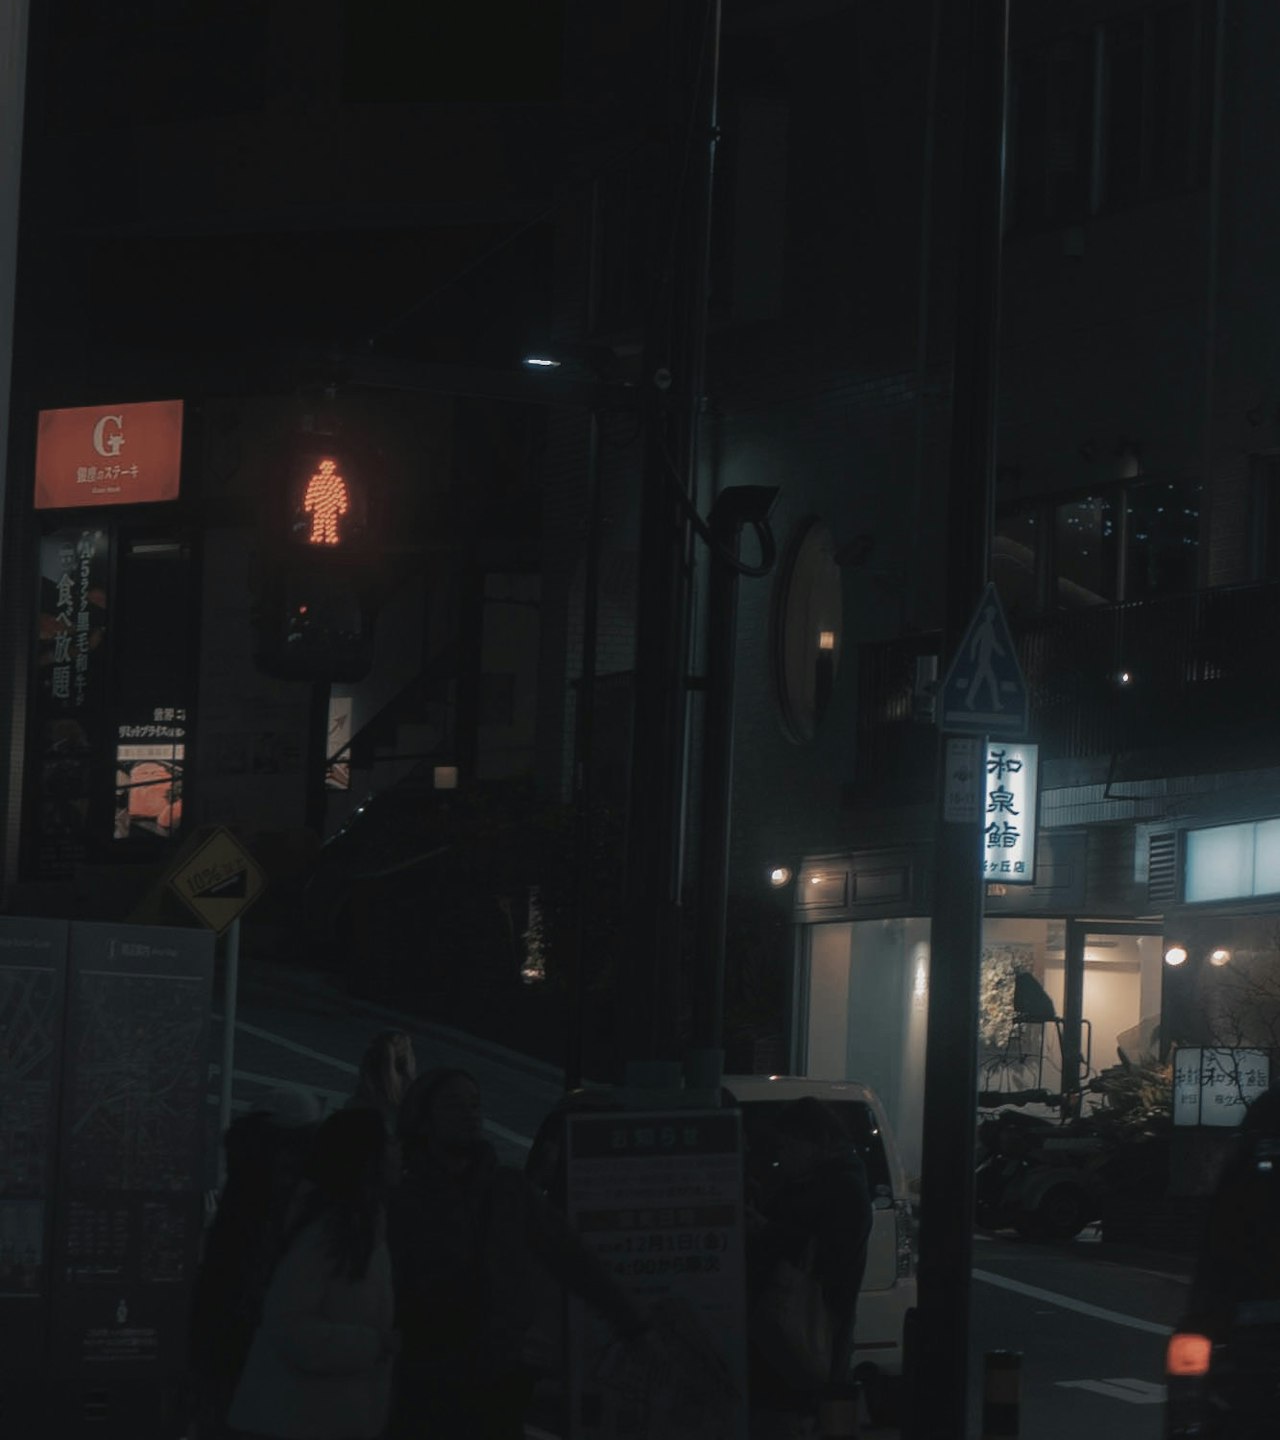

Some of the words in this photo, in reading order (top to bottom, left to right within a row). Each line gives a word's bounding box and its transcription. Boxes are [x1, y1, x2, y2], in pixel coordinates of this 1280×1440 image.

[985, 749, 1024, 849] 和泉鮨
[611, 1125, 700, 1149] お知らせ
